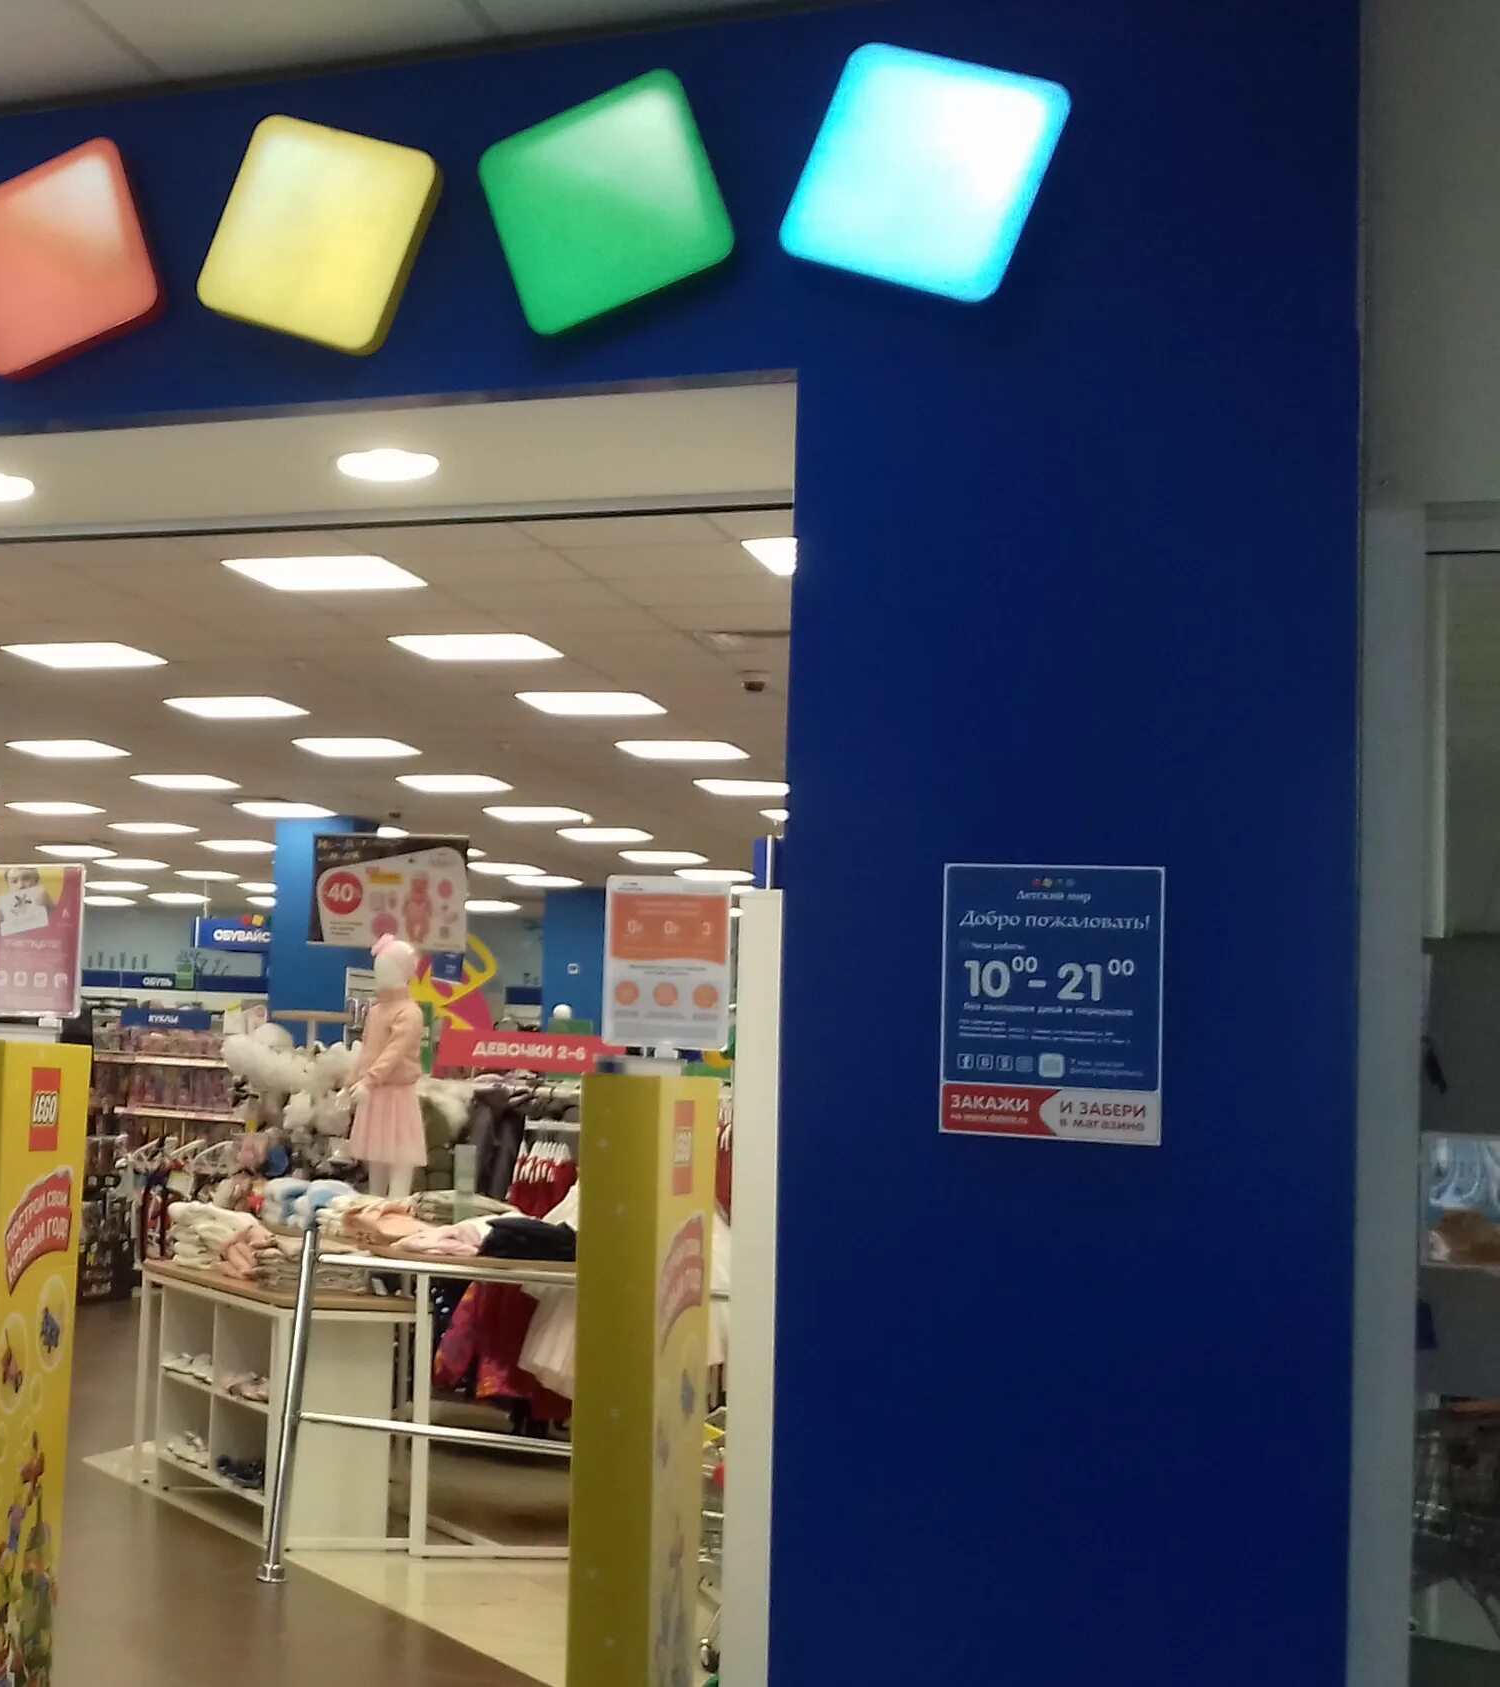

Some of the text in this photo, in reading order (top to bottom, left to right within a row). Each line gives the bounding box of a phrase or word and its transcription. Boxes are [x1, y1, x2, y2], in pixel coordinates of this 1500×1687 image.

[959, 910, 1151, 931] Добро пожаловать!
[213, 928, 272, 943] ОБУВАЙС
[472, 1041, 587, 1061] ДЕВОЧКИ 2-6
[32, 1091, 59, 1126] LEGO
[950, 1094, 1030, 1113] ЗАКАЖИ
[1060, 1100, 1146, 1119] И ЗАБЕРИ
